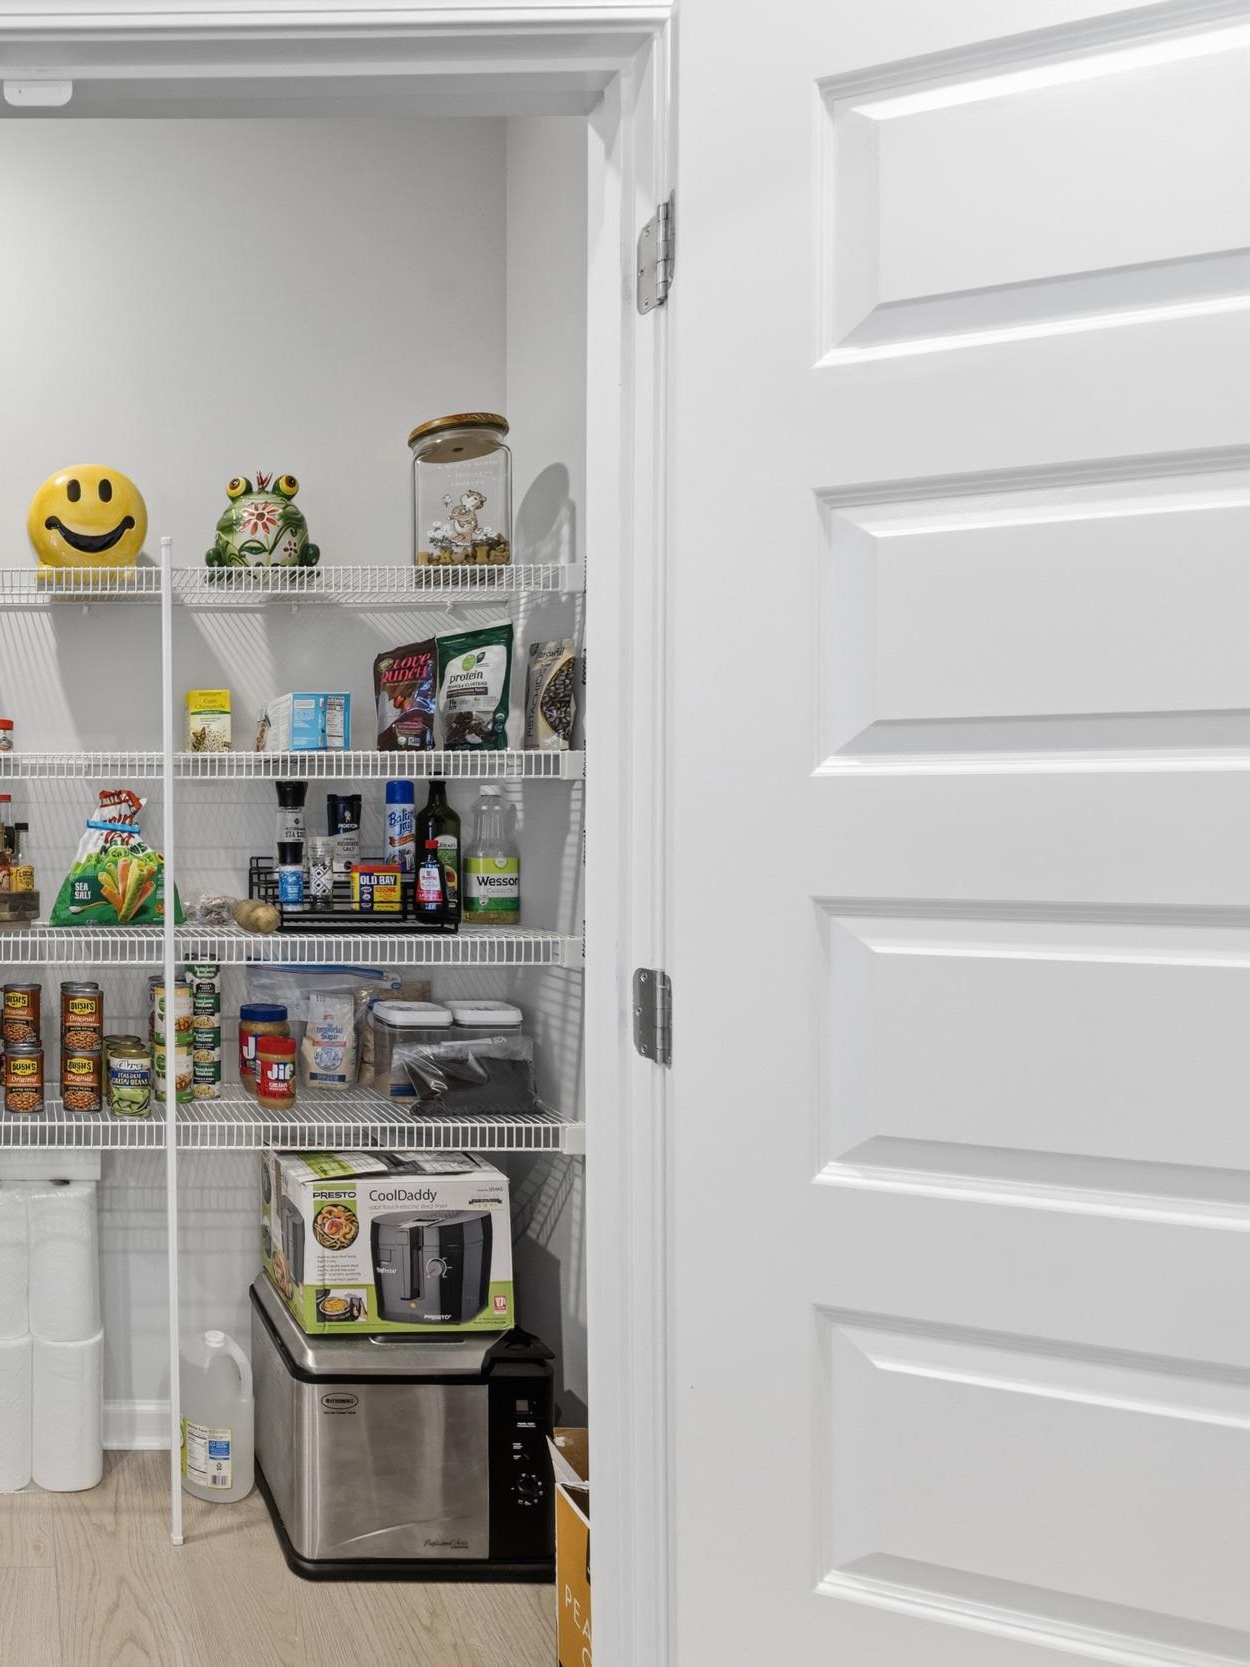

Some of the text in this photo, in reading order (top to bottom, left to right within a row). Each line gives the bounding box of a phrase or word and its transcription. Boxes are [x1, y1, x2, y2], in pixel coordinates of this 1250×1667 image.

[449, 670, 484, 684] protein
[360, 875, 396, 885] OLD BAY
[74, 882, 89, 891] SEA
[74, 891, 91, 900] SALT
[70, 1002, 94, 1010] BUSH'S
[12, 1063, 36, 1071] BUSH'S
[267, 1063, 294, 1080] Jif
[312, 1191, 357, 1200] PRESTO
[369, 1189, 438, 1204] CoolDaddy
